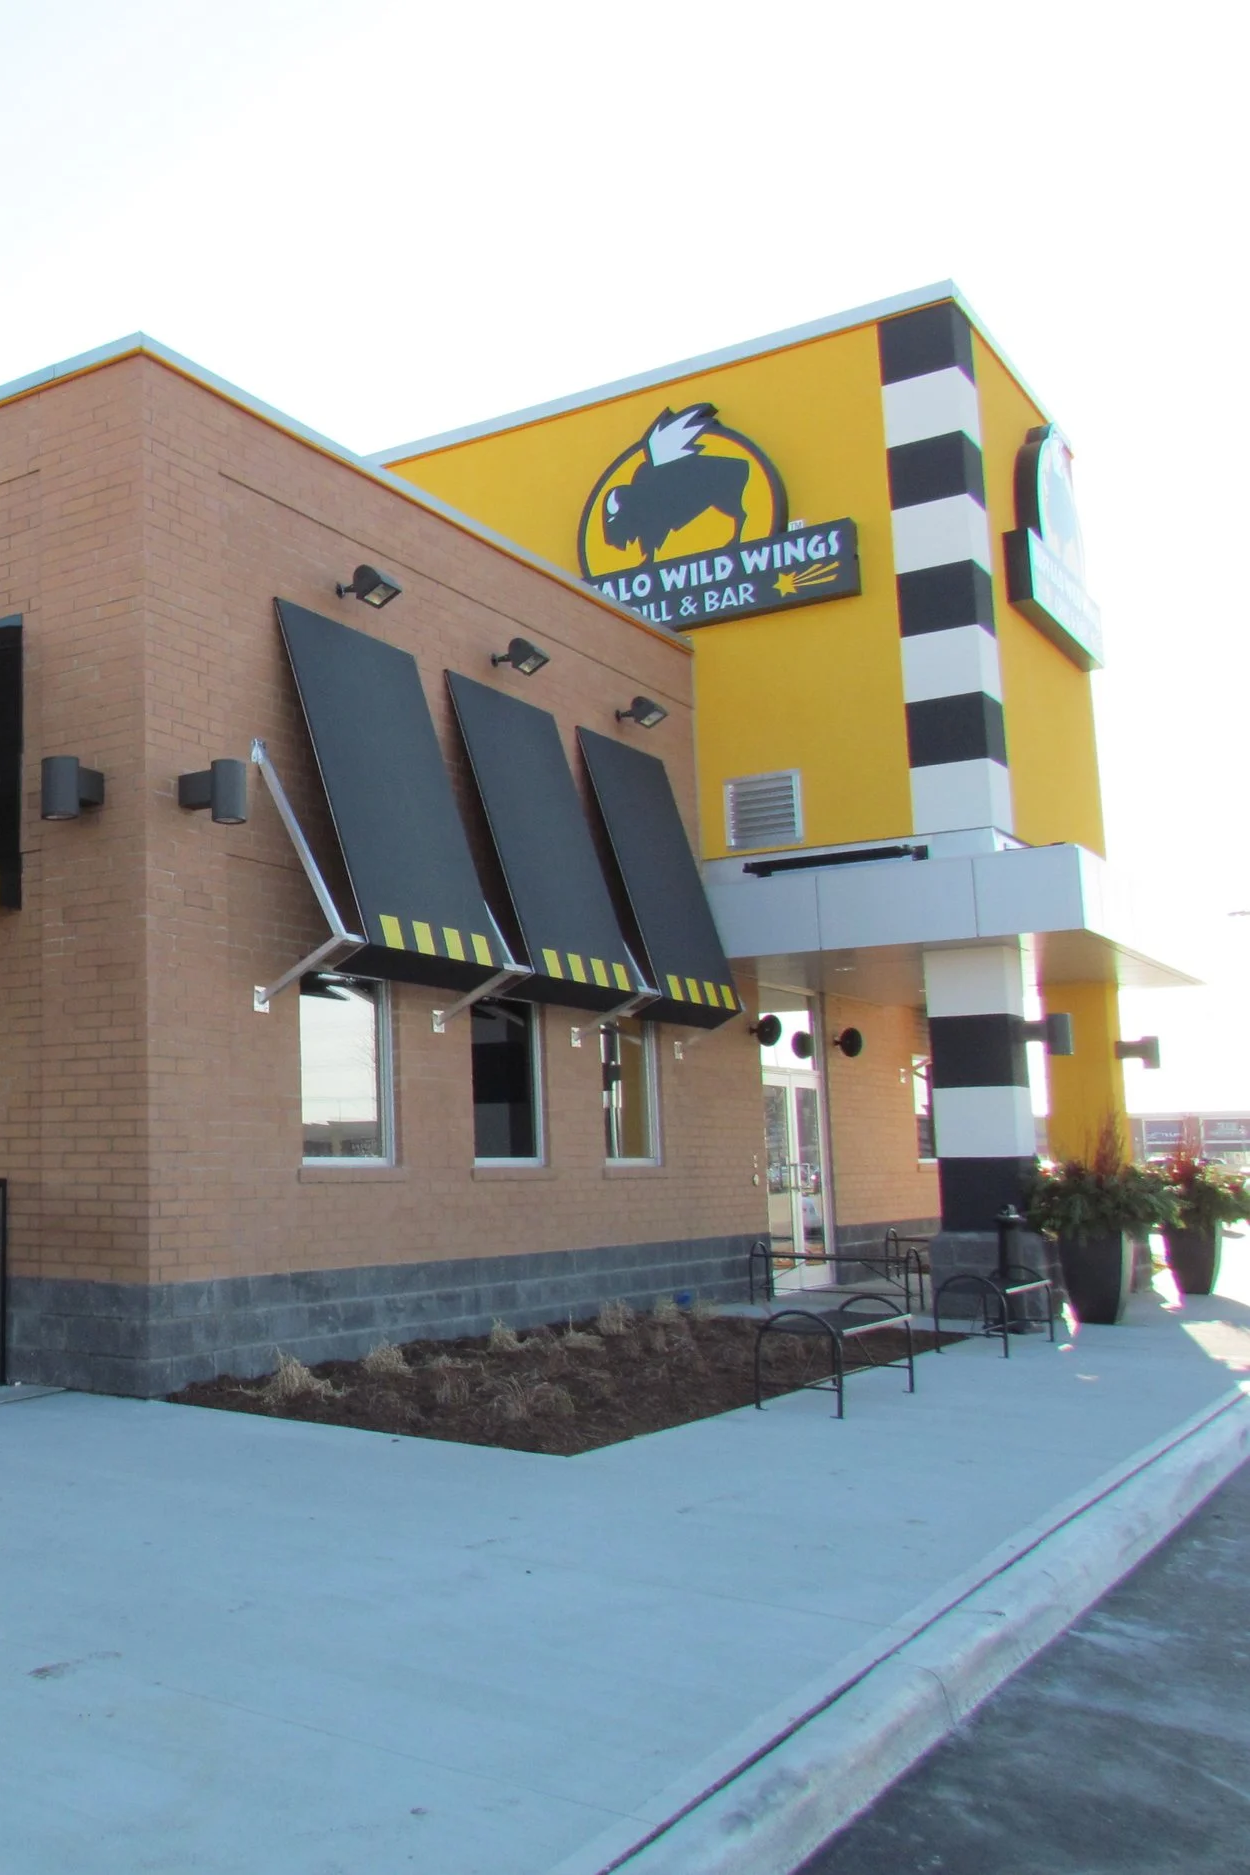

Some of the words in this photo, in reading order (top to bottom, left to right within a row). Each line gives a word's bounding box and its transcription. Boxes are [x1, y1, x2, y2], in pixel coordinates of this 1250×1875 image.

[593, 573, 651, 602] ALO
[659, 555, 733, 593] WILD
[740, 530, 839, 575] WINGS
[632, 600, 672, 623] ILL
[679, 596, 698, 617] &
[704, 582, 755, 612] BAR
